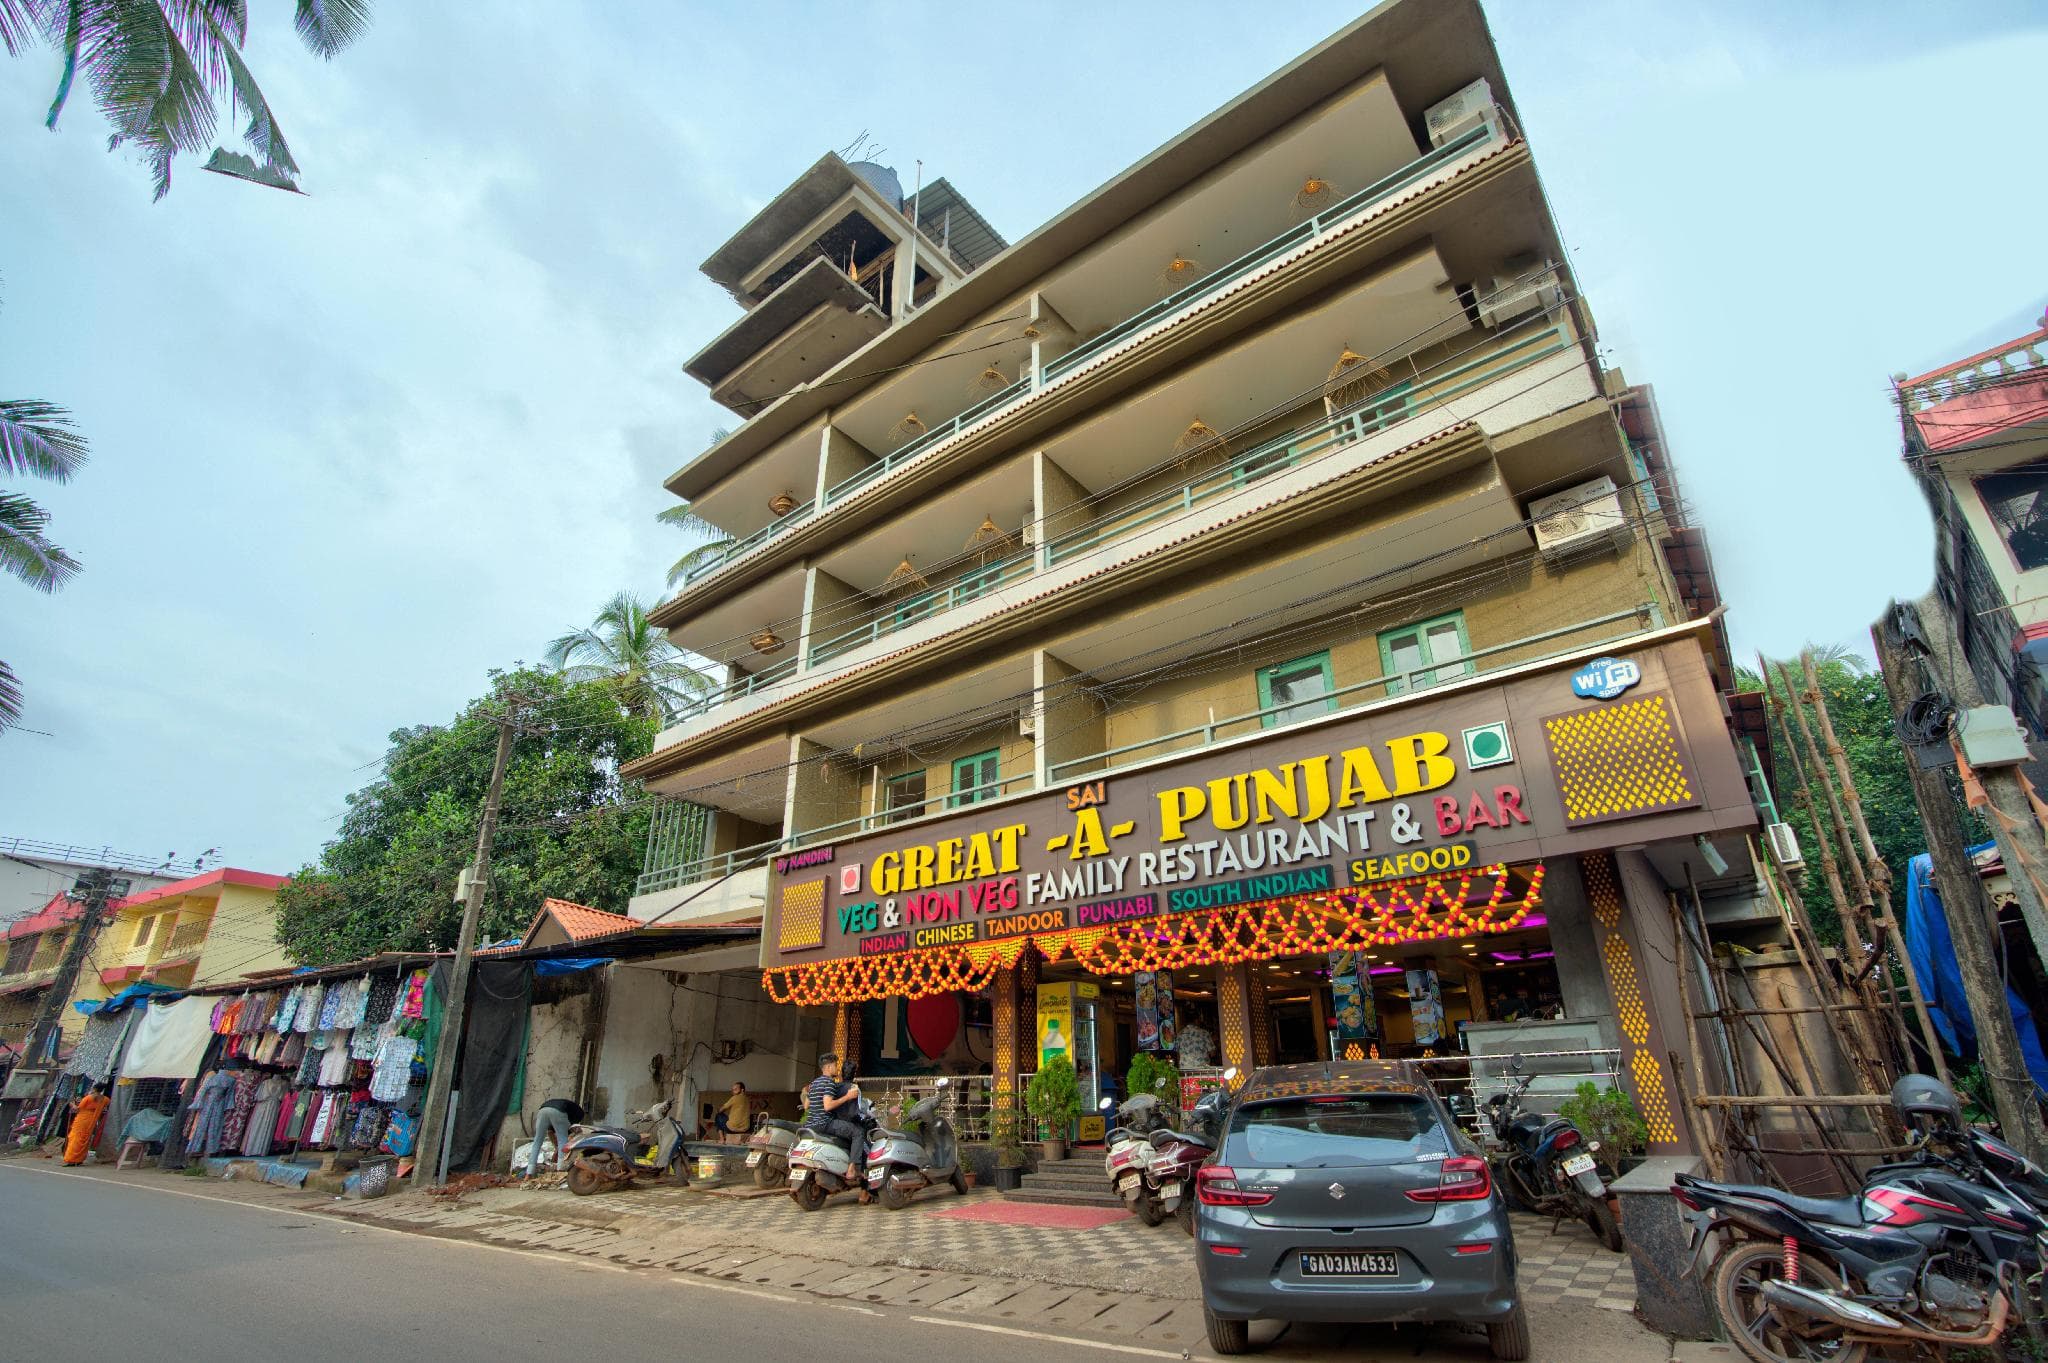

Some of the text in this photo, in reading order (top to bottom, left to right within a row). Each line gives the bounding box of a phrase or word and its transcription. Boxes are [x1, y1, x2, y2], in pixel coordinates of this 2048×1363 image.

[1591, 660, 1612, 669] Free
[1066, 781, 1106, 810] SAI
[870, 824, 1026, 896] GREAT
[1157, 731, 1457, 842] PUNJAB
[777, 847, 833, 874] By NANDINI
[837, 784, 1530, 935] VEG & NON VEG FAMILY RESTAURANT & BAR
[1351, 845, 1471, 883] SEAFOOD
[1171, 867, 1328, 911] SOUTH INDIAN
[986, 910, 1065, 937] TANDOOR
[1080, 896, 1154, 924] PUNJABI
[861, 934, 905, 955] INDIAN
[916, 923, 974, 947] CHINESE
[1309, 1255, 1396, 1273] GA03AH4533
